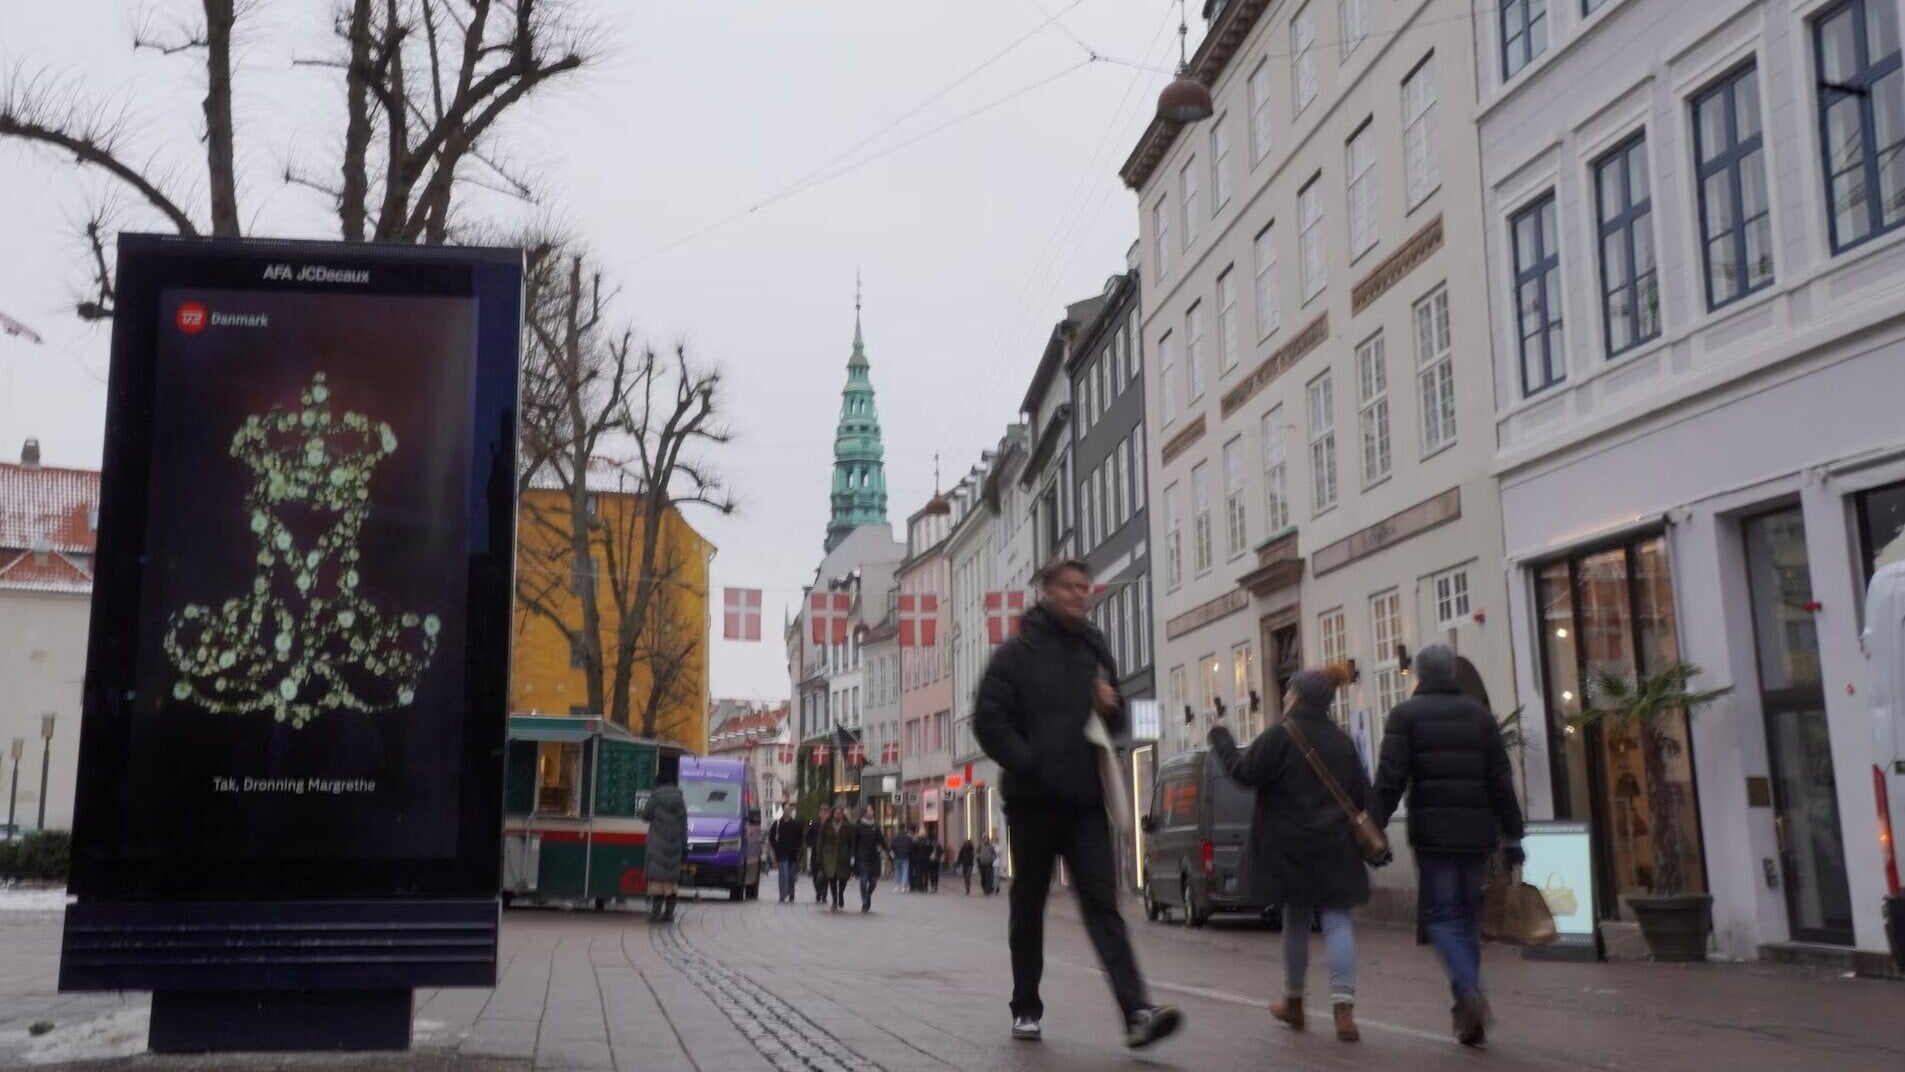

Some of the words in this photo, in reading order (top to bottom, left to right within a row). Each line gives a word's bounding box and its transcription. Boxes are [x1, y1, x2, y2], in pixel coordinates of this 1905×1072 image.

[262, 264, 292, 280] AFA
[296, 265, 370, 283] JCDecaux
[211, 311, 269, 327] Danmark
[213, 776, 239, 792] Tak,
[243, 776, 304, 794] Dronning
[307, 777, 376, 794] Margrethe
